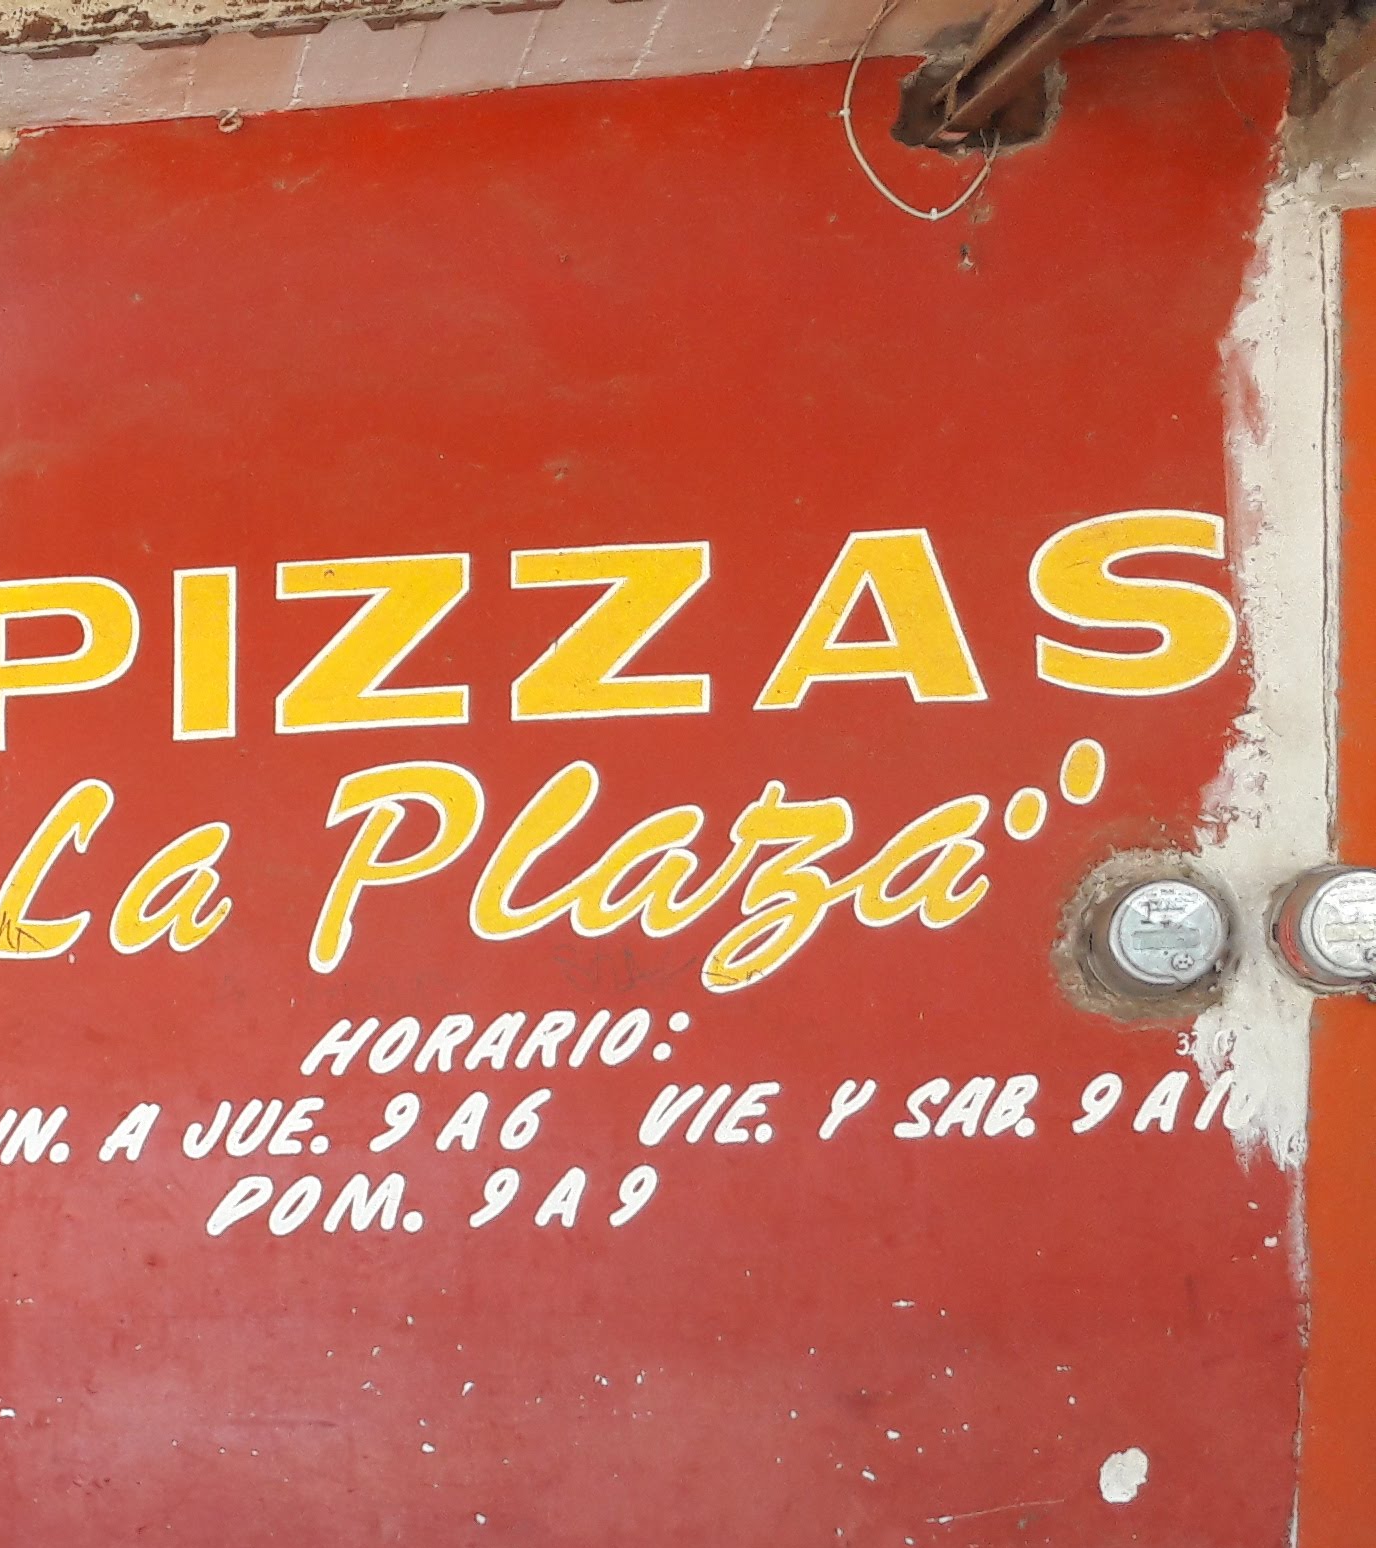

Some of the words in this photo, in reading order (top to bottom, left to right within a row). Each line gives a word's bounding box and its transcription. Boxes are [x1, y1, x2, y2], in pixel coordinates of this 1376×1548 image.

[298, 1006, 691, 1078] HORARIO:
[97, 1101, 163, 1163] A
[181, 1096, 331, 1161] JUE.
[368, 1091, 422, 1154] 9
[434, 1090, 491, 1153] A
[498, 1087, 553, 1152] 6
[637, 1080, 783, 1148] VIE.
[817, 1077, 878, 1142] Y
[892, 1073, 1040, 1139] SAB.
[1070, 1070, 1124, 1135] 9
[1131, 1069, 1191, 1134] A
[205, 1171, 425, 1238] DOM.
[468, 1166, 522, 1229] 9
[533, 1165, 589, 1229] A
[608, 1163, 659, 1229] 9
